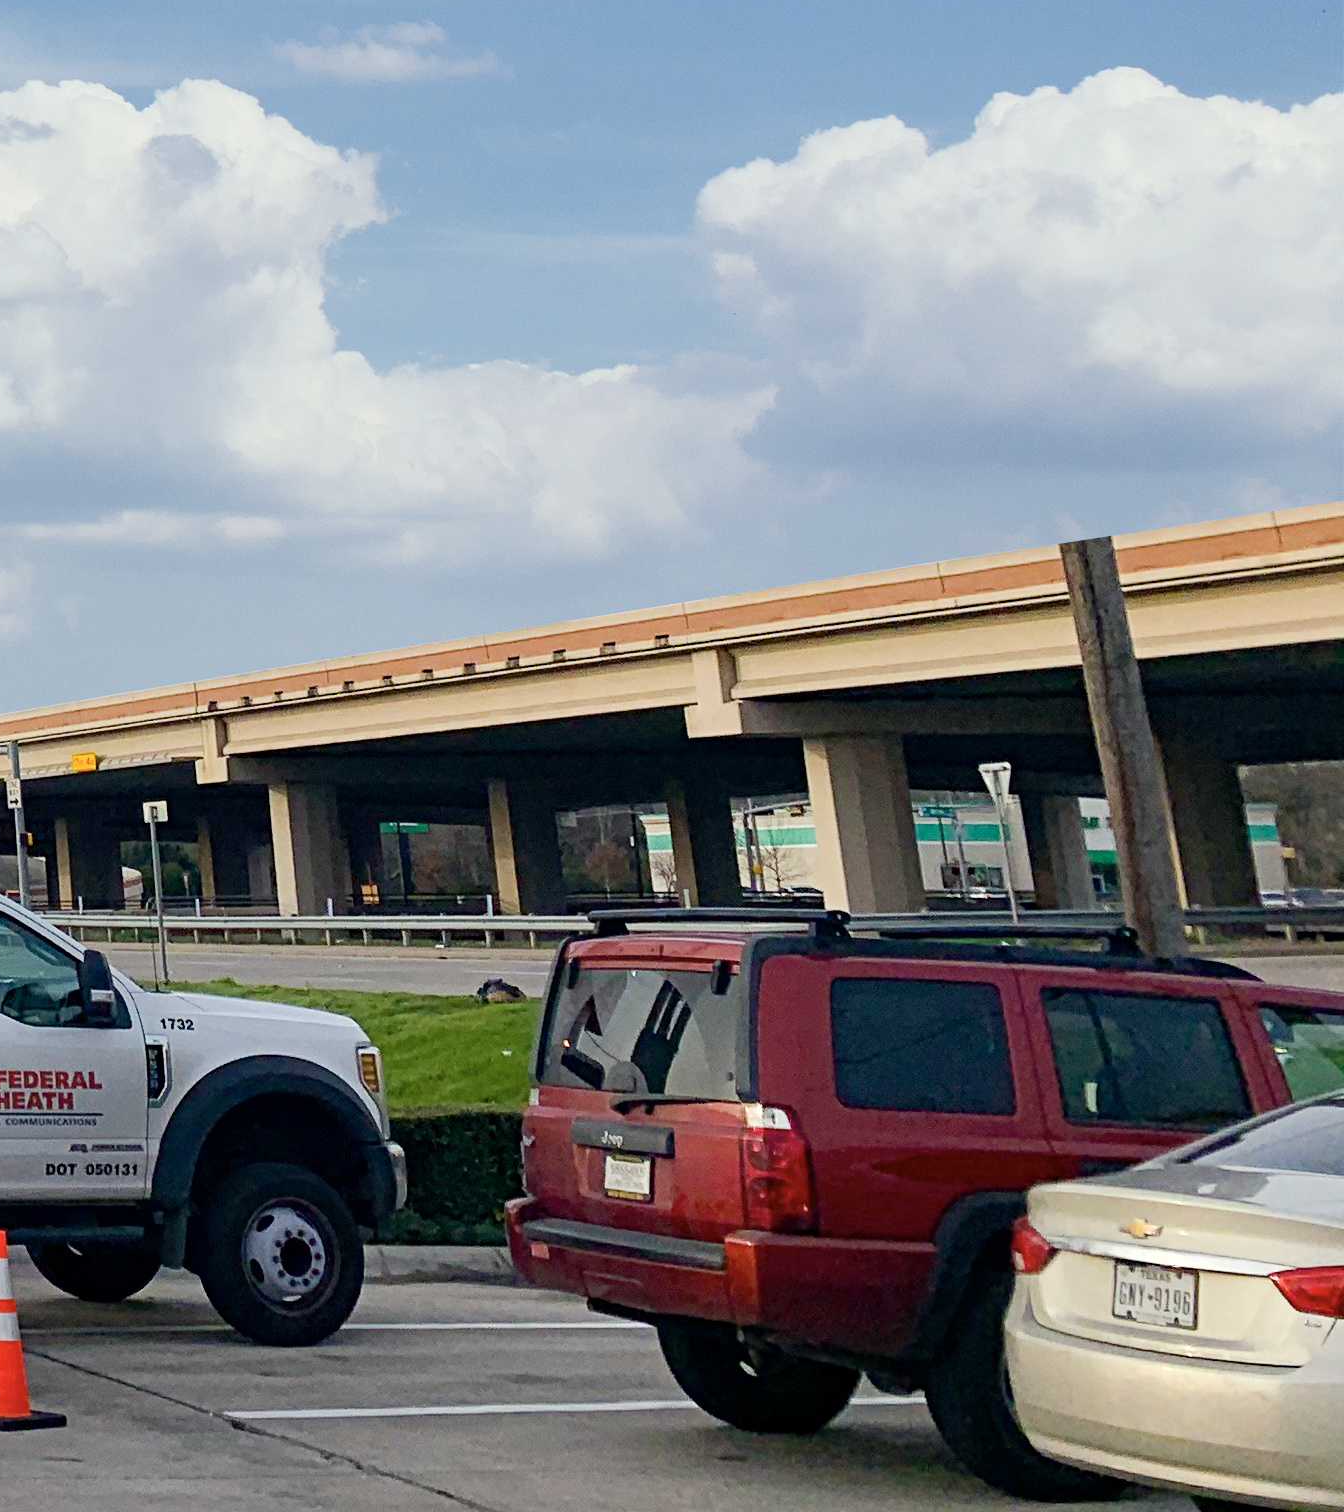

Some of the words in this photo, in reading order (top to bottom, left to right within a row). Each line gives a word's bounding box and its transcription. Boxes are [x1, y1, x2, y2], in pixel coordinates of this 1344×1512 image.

[160, 1018, 194, 1031] 1732
[5, 1117, 97, 1127] COMMUNICATIONS
[600, 1131, 624, 1148] Jeep
[45, 1163, 77, 1176] DOT
[85, 1163, 138, 1176] 050131
[1142, 1270, 1171, 1281] TEXAS
